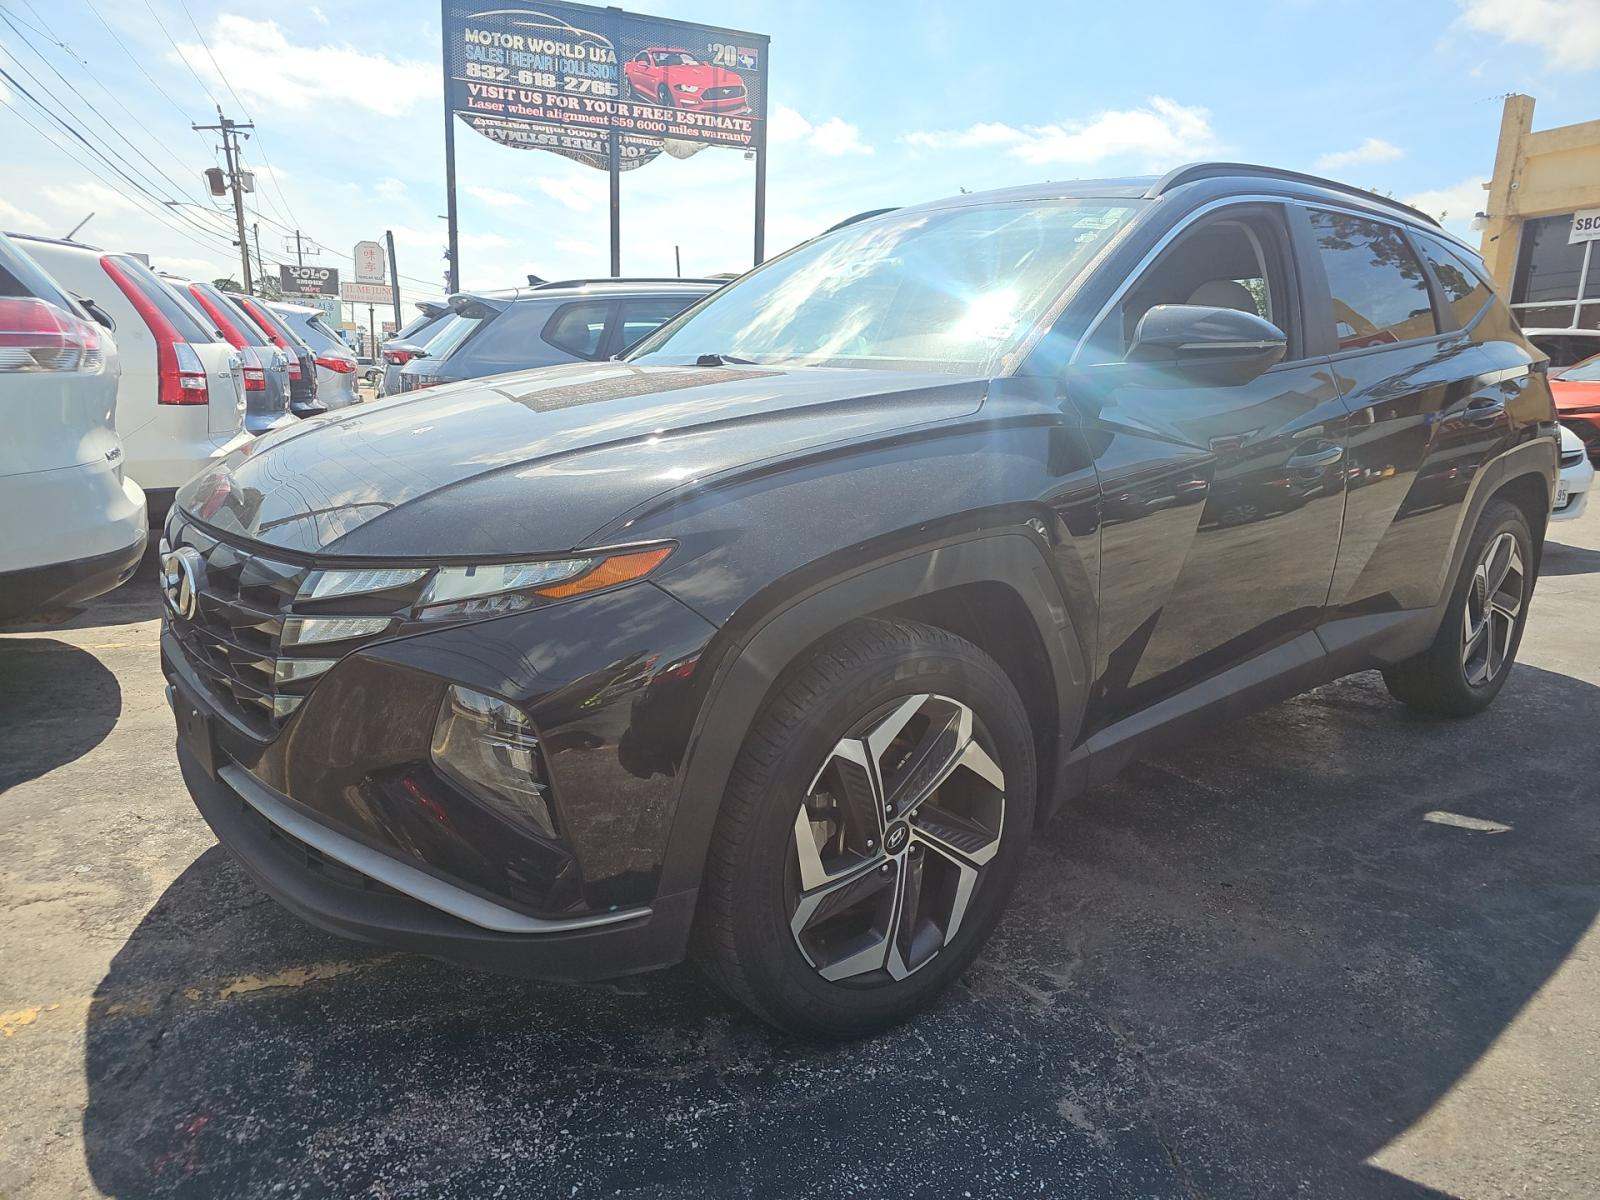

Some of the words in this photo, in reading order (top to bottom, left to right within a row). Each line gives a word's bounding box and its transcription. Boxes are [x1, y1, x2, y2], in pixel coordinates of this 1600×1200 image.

[465, 28, 524, 50] MOTOR
[527, 37, 585, 59] WORLD
[589, 47, 618, 64] USA
[465, 45, 505, 64] SALES
[511, 51, 553, 71] REPAIR
[560, 58, 618, 80] COLLISION
[467, 83, 516, 100] VISIT
[519, 91, 542, 105] US
[546, 94, 580, 110] FOR
[583, 99, 630, 116] YOUR
[633, 105, 673, 122] FREE
[676, 111, 752, 132] ESTIMATE
[467, 97, 504, 112] Laser
[508, 104, 544, 117] wheel
[546, 109, 609, 125] alignment
[636, 120, 667, 133] 6000
[668, 124, 700, 137] miles
[701, 129, 752, 144] warranty
[289, 266, 330, 280] YOLO
